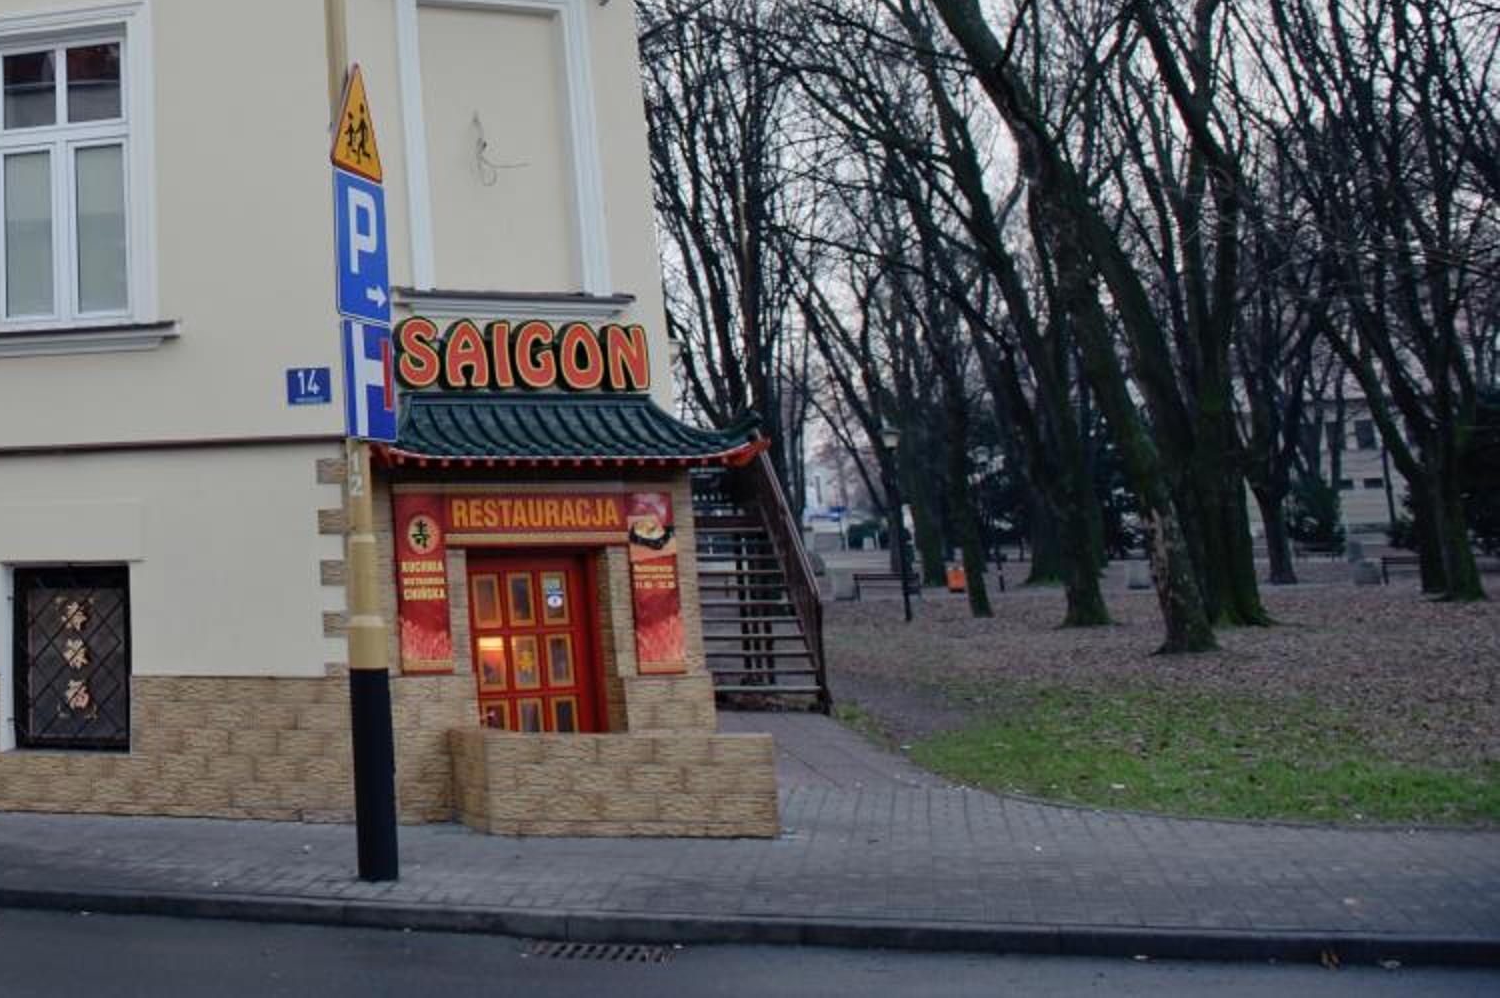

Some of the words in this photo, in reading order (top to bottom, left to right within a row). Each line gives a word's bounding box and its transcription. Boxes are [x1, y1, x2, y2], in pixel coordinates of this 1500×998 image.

[347, 185, 377, 275] P
[394, 316, 651, 391] SAIGON
[297, 369, 321, 395] 14
[451, 498, 621, 528] RESTAURACJA
[401, 560, 444, 573] KUCHNIA
